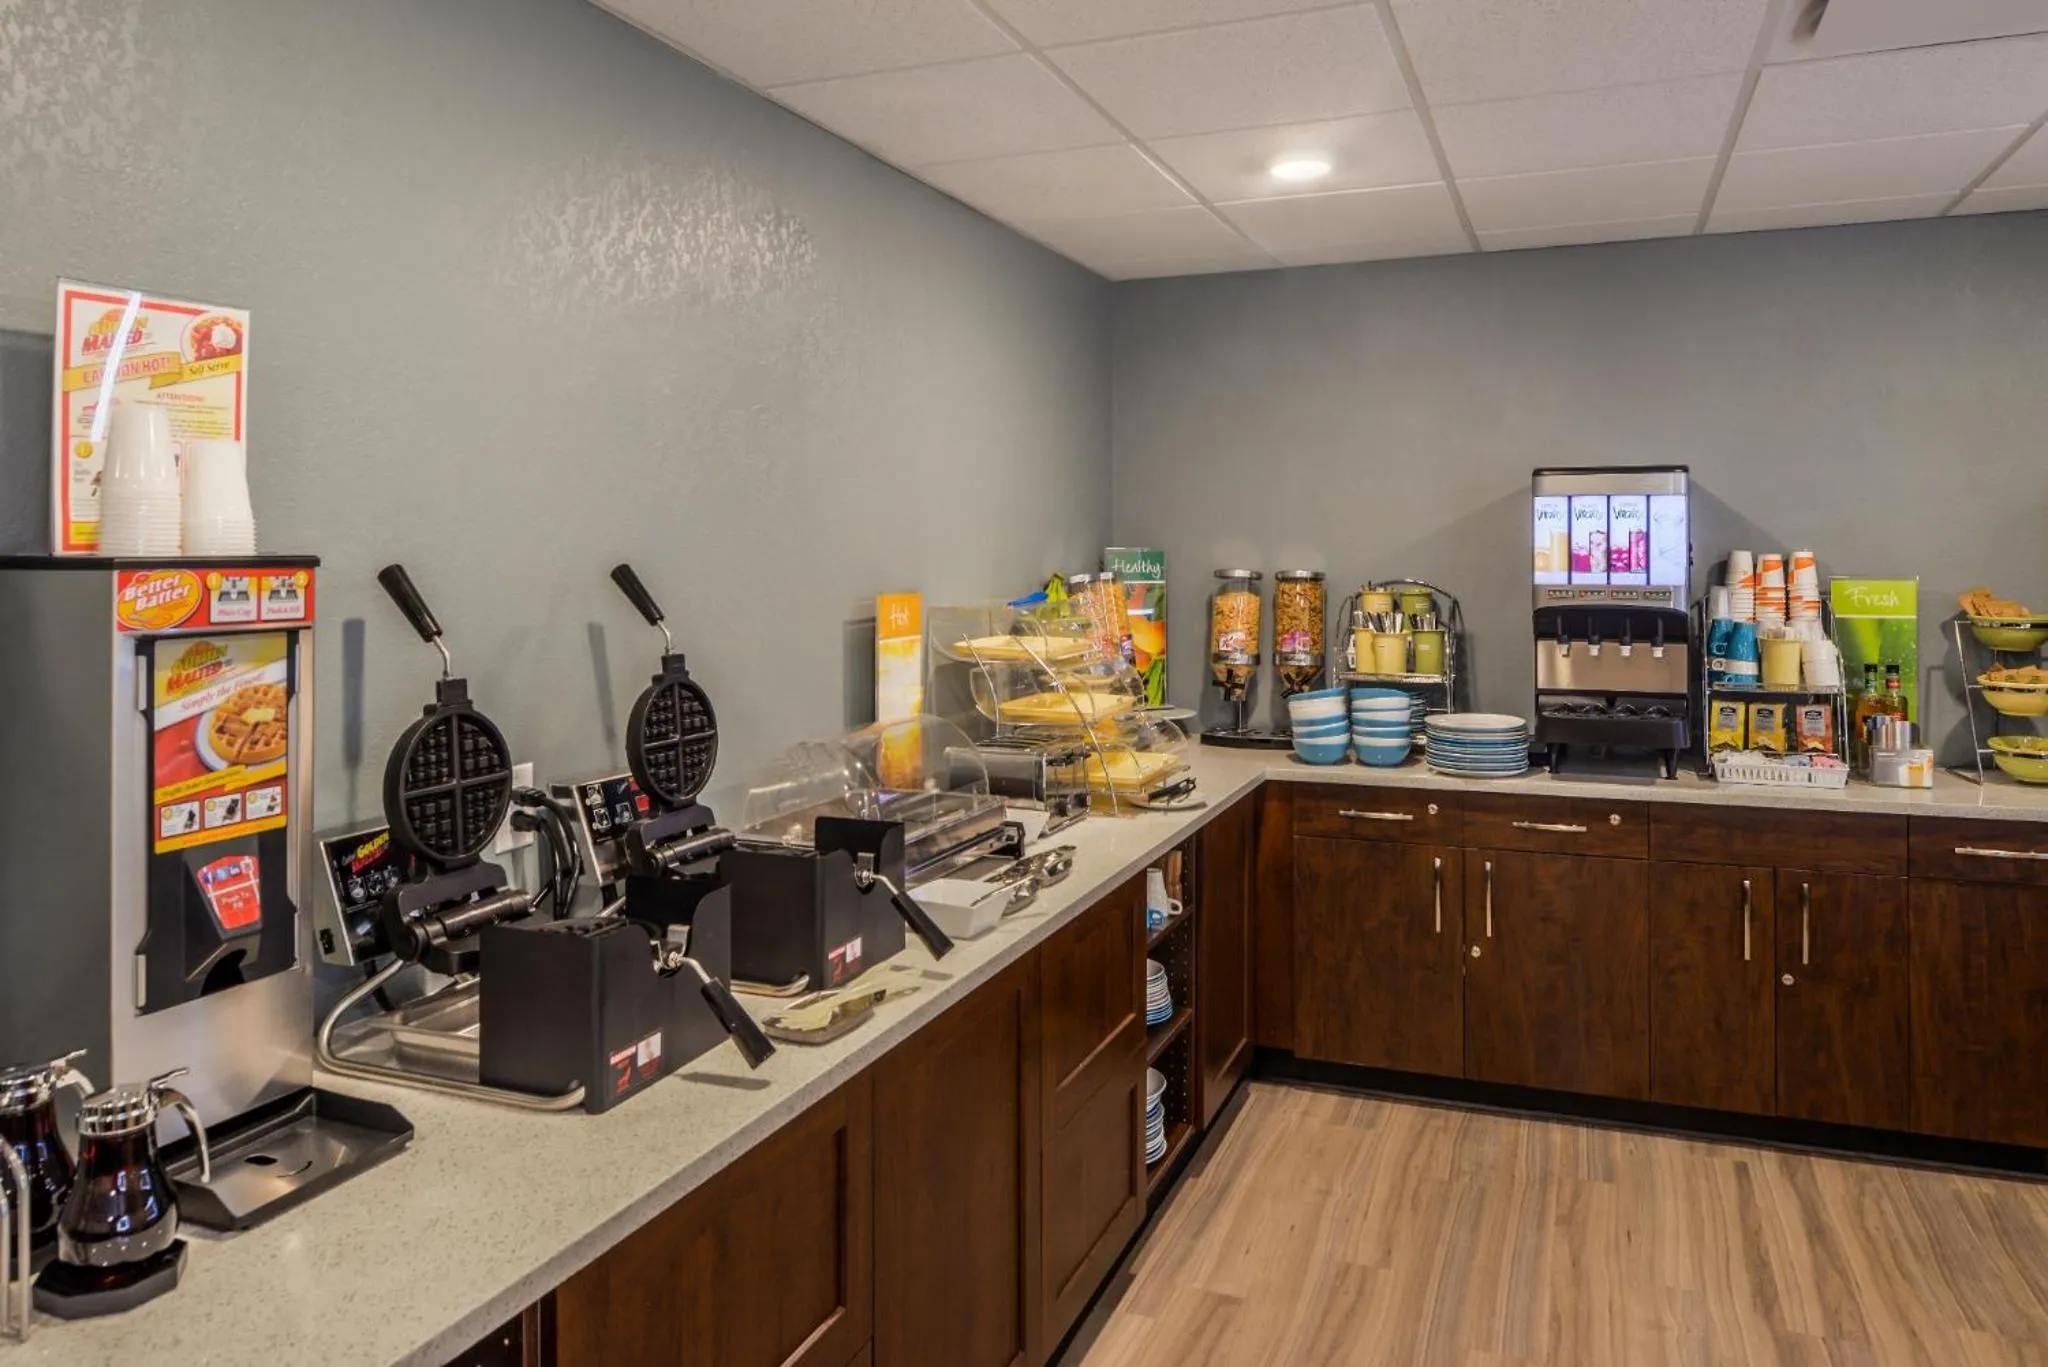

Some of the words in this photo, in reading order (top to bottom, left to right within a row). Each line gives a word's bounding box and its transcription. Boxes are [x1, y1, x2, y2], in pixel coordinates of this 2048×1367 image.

[81, 327, 143, 356] MALED
[1111, 558, 1164, 579] Healthy
[124, 573, 182, 602] Better
[134, 583, 193, 612] Batter
[1843, 585, 1900, 608] Fresh
[889, 603, 910, 631] Hot
